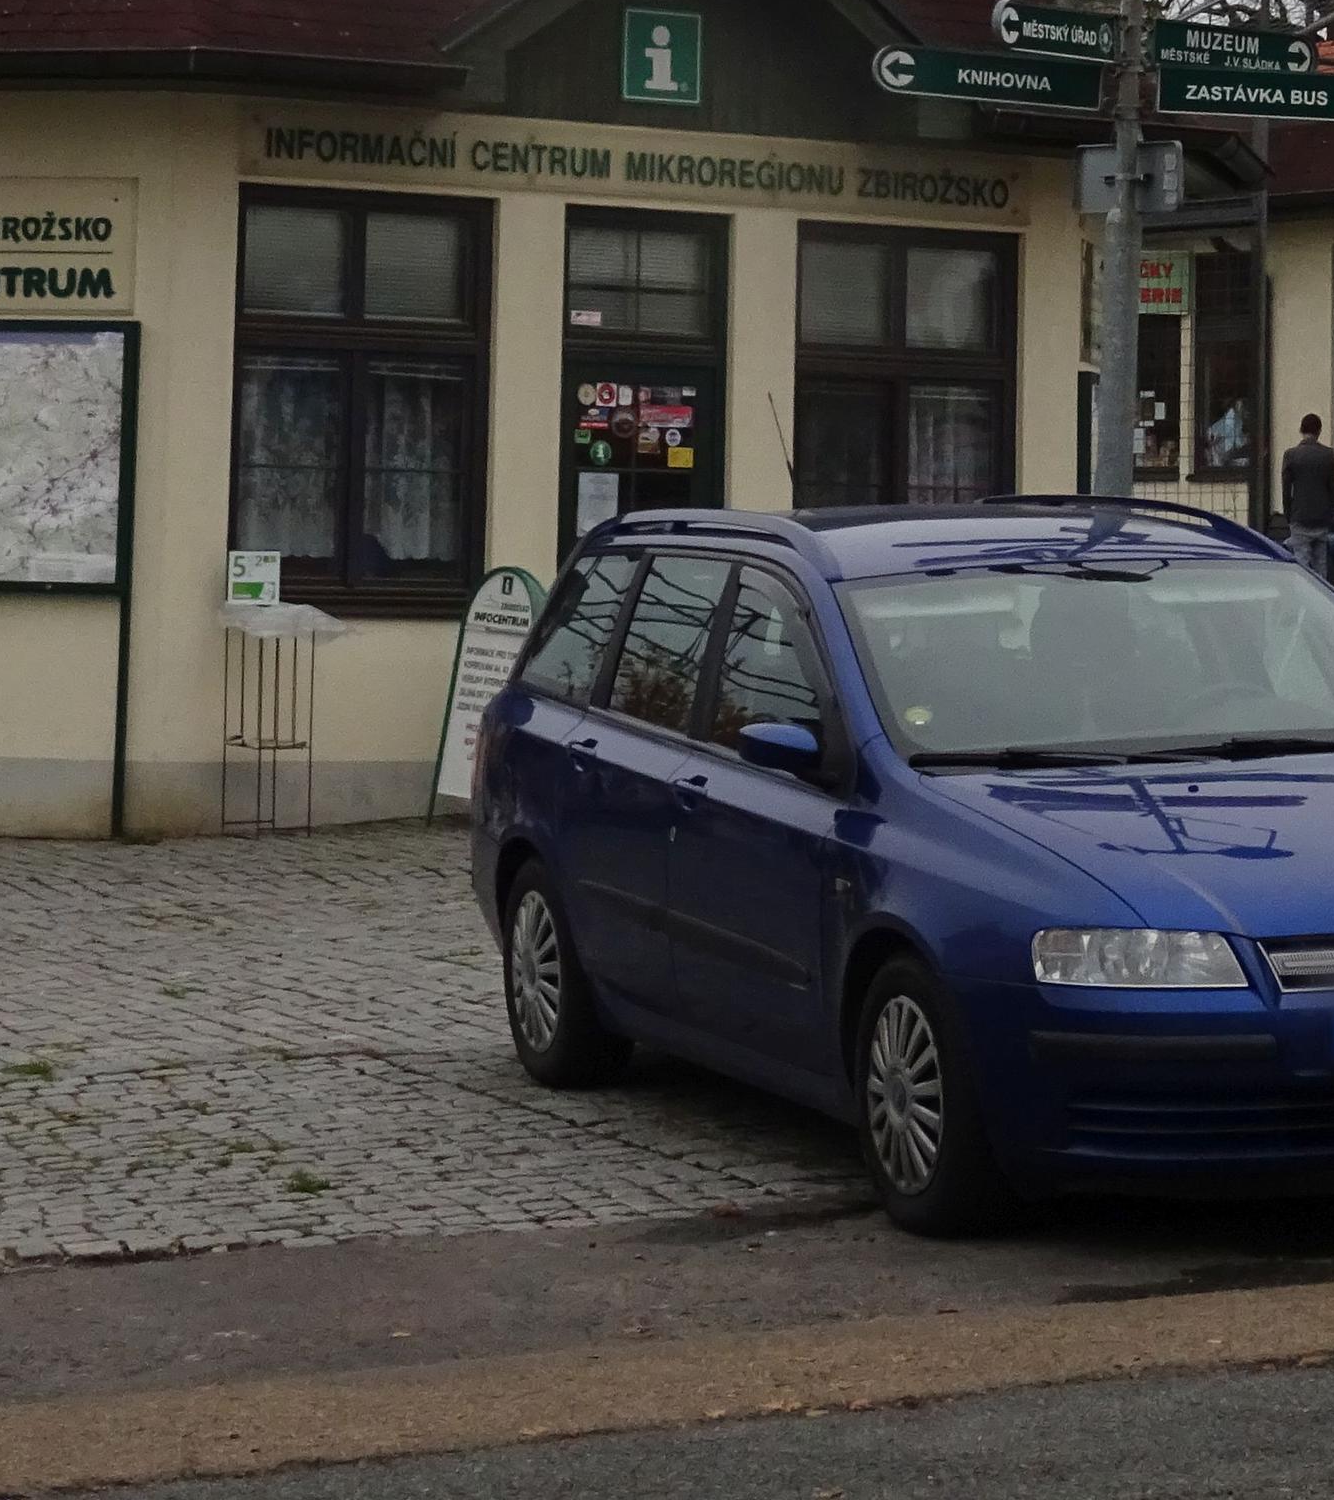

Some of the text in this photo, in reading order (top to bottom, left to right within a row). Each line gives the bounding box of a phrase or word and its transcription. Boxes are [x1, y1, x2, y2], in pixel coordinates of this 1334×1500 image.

[1022, 19, 1097, 46] MĚSTSKÝ ÚŘAD
[1186, 29, 1260, 55] MUZEUM
[1161, 48, 1211, 65] MĚSTSKÉ
[958, 69, 1052, 91] KNIHOVNA
[1185, 84, 1328, 106] ZASTÁVKA BUS
[266, 127, 1009, 209] INFORMAČNÍ CENTRUM MIKROREGIONU ZBIROŽSKO
[1140, 259, 1174, 278] ČKY
[1139, 288, 1183, 304] ERIE
[473, 611, 530, 628] INFOCENTRUM
